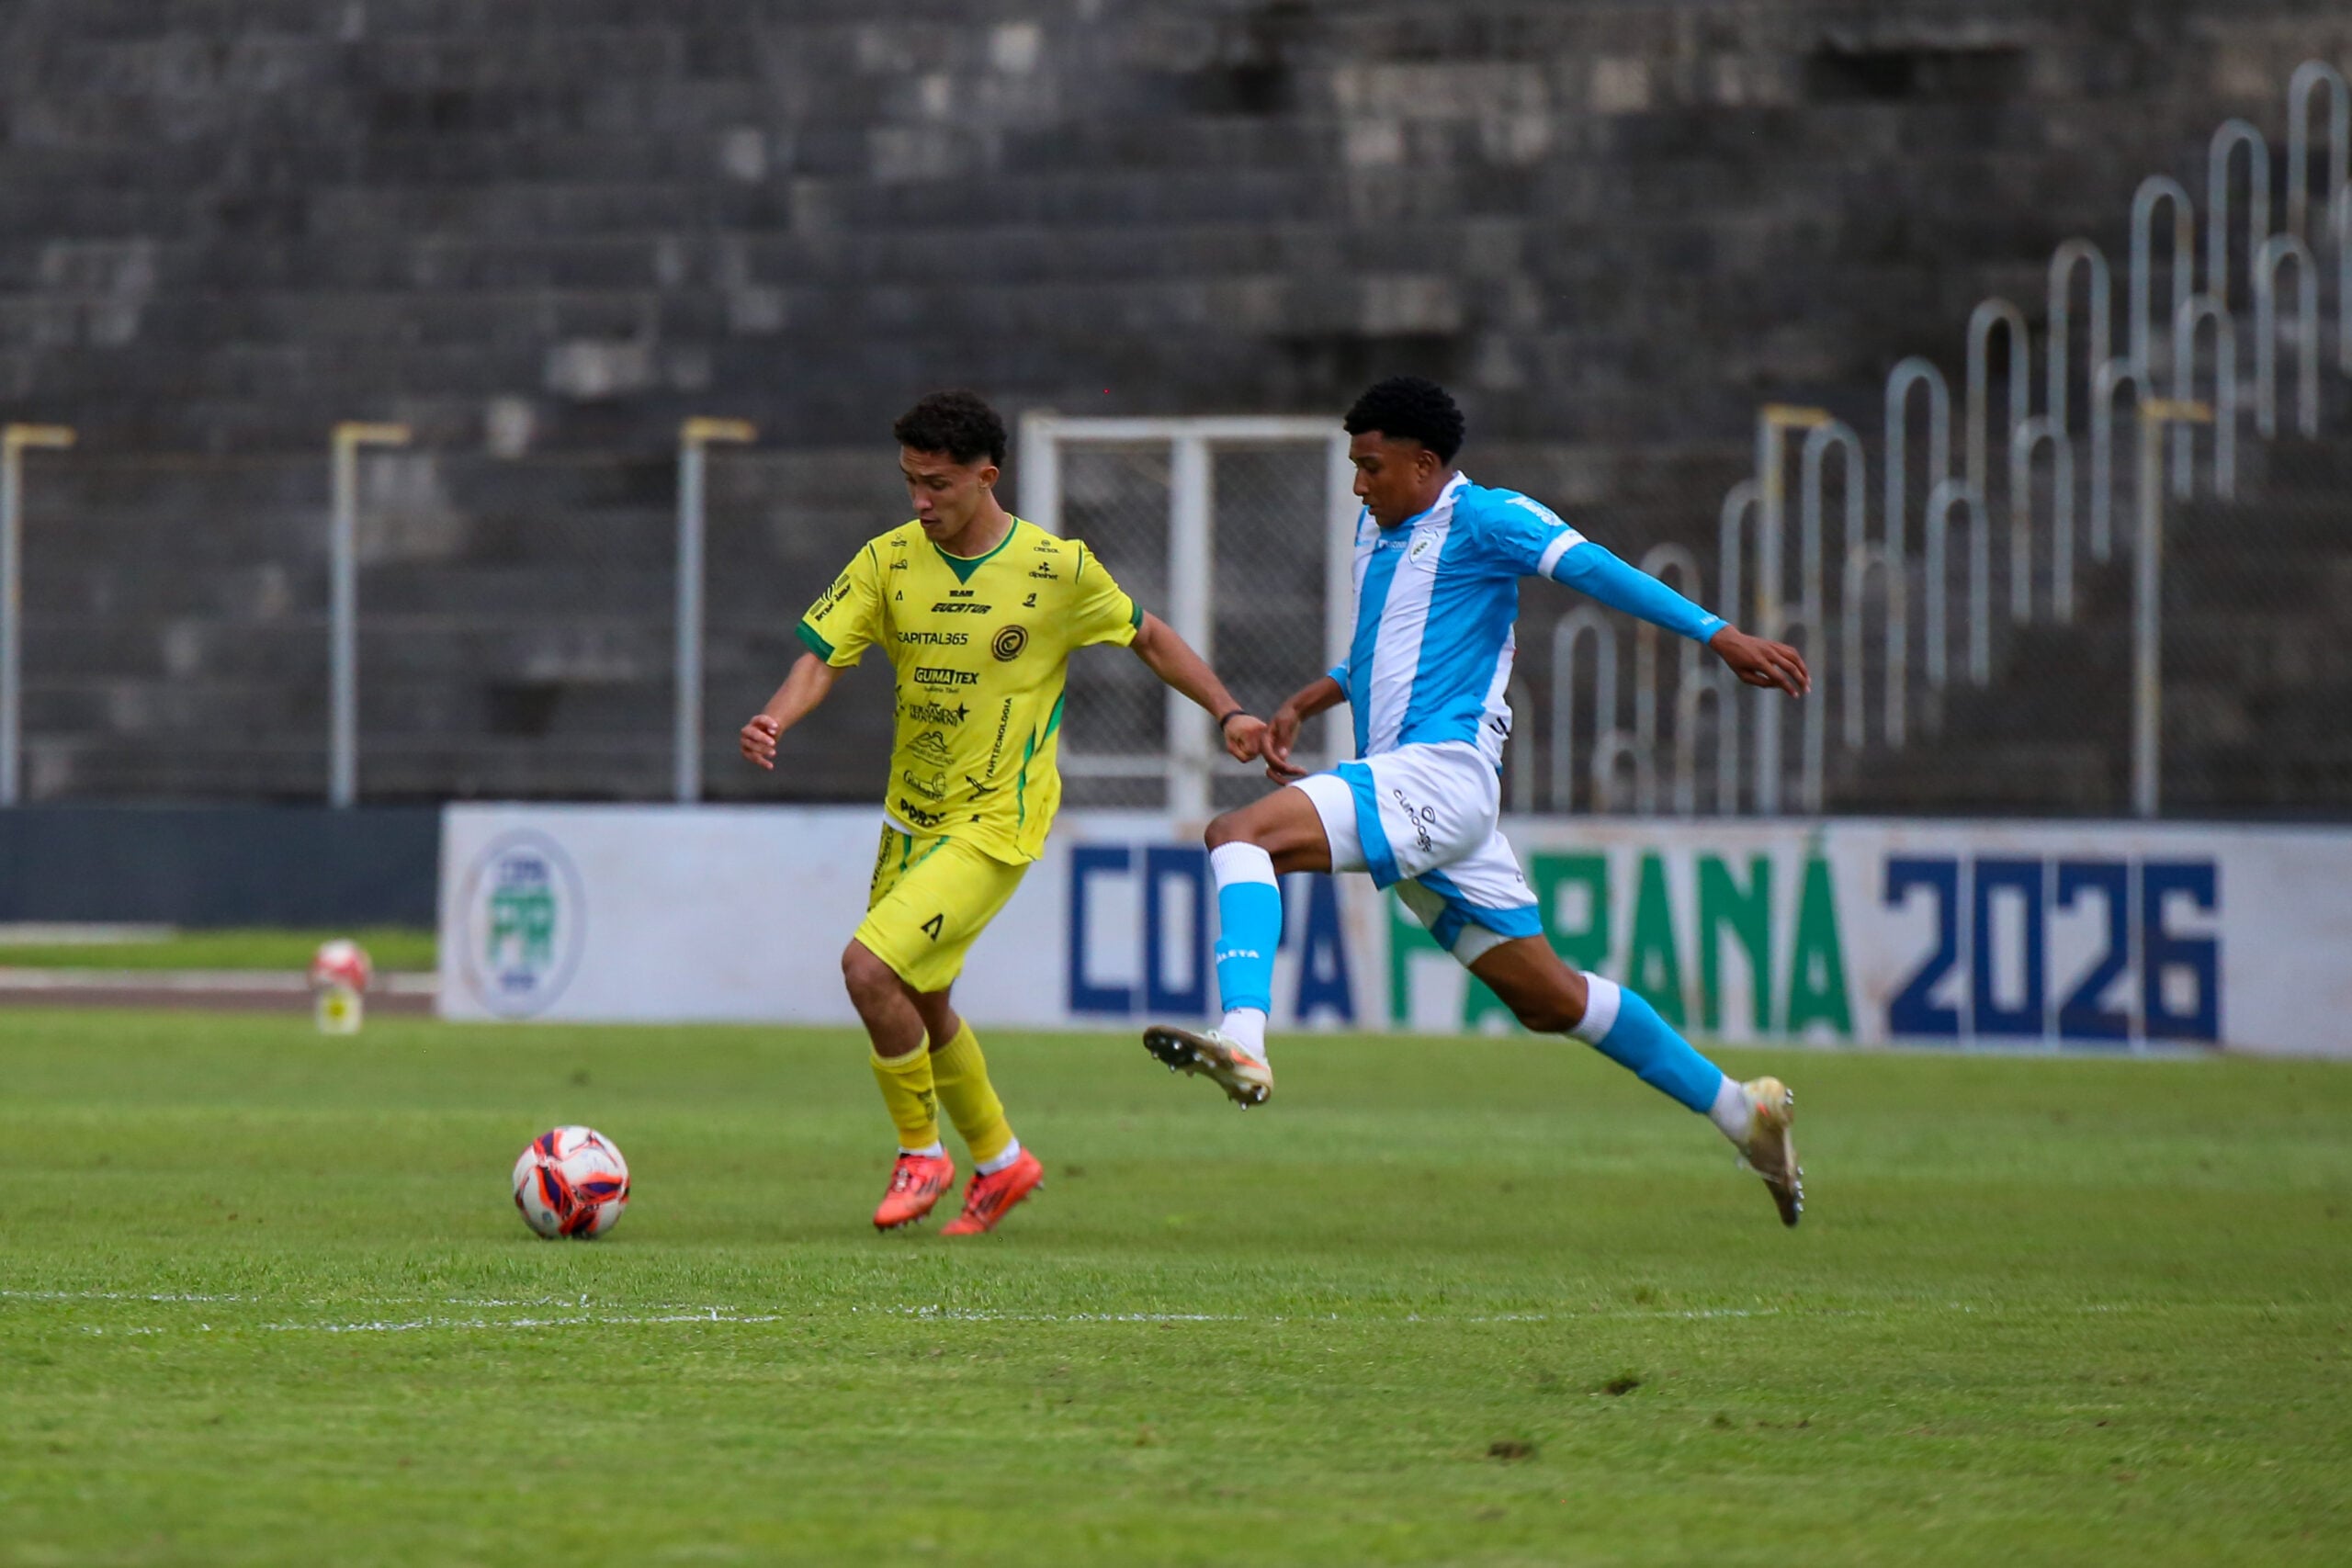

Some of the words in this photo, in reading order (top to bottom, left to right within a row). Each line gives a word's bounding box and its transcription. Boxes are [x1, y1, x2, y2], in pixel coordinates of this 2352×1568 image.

[897, 632, 969, 645] CAPITAL365
[1070, 845, 1355, 1023] COA
[1885, 852, 2220, 1043] 2026
